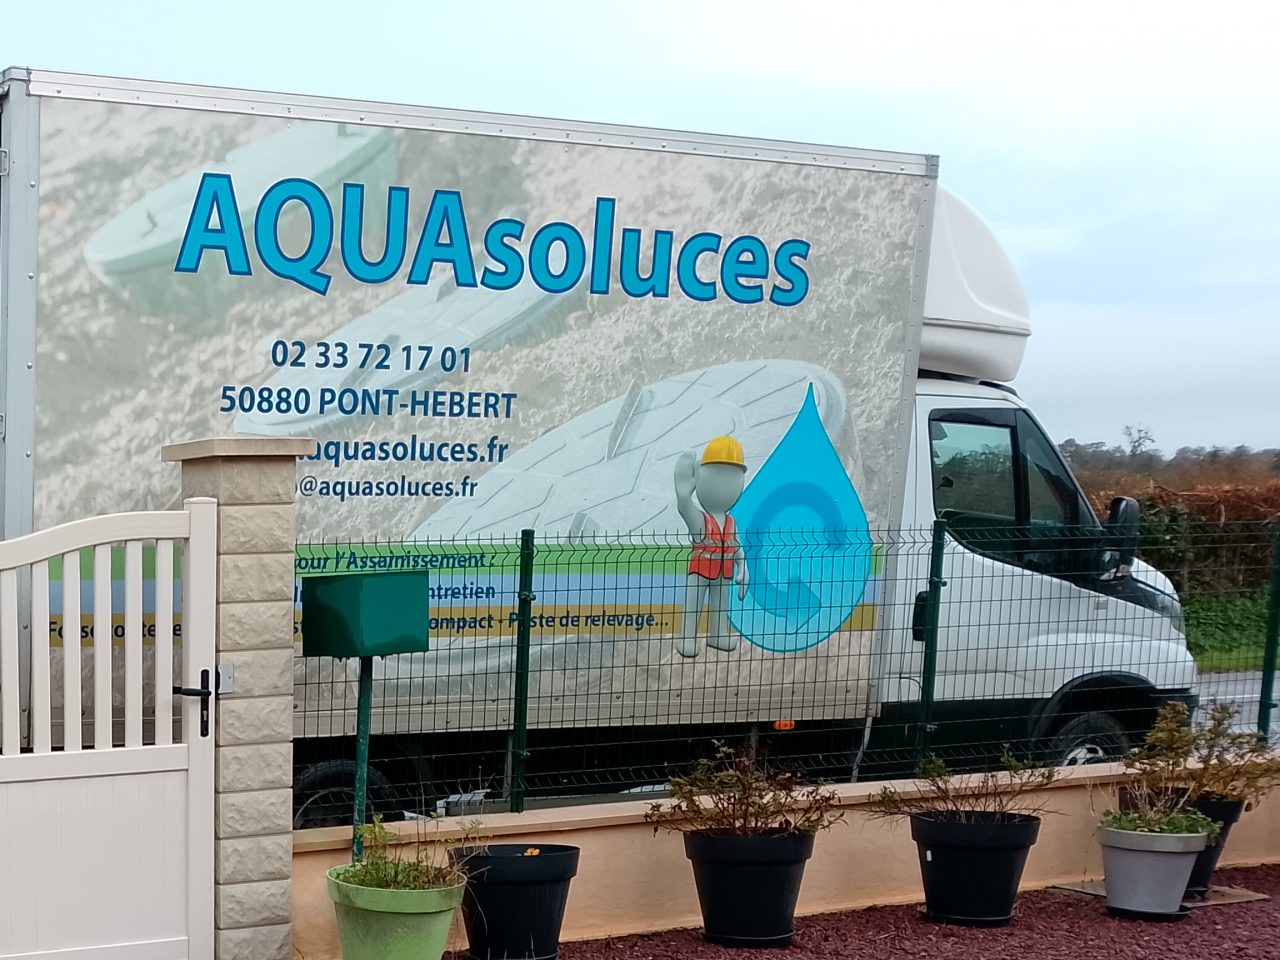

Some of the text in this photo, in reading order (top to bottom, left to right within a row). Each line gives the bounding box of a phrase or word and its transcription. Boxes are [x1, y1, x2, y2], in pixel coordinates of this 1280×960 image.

[173, 172, 811, 306] AQUAsoluces
[271, 340, 470, 373] 02 33 72 17 01
[220, 386, 518, 418] 50880 PONT-HEBERT
[298, 434, 509, 468] .aquasoluces.fr
[295, 475, 478, 502] @aquasoluces.fr
[428, 581, 496, 600] ntretien
[428, 615, 495, 634] ompact
[508, 612, 556, 628] Pste
[559, 611, 580, 627] de
